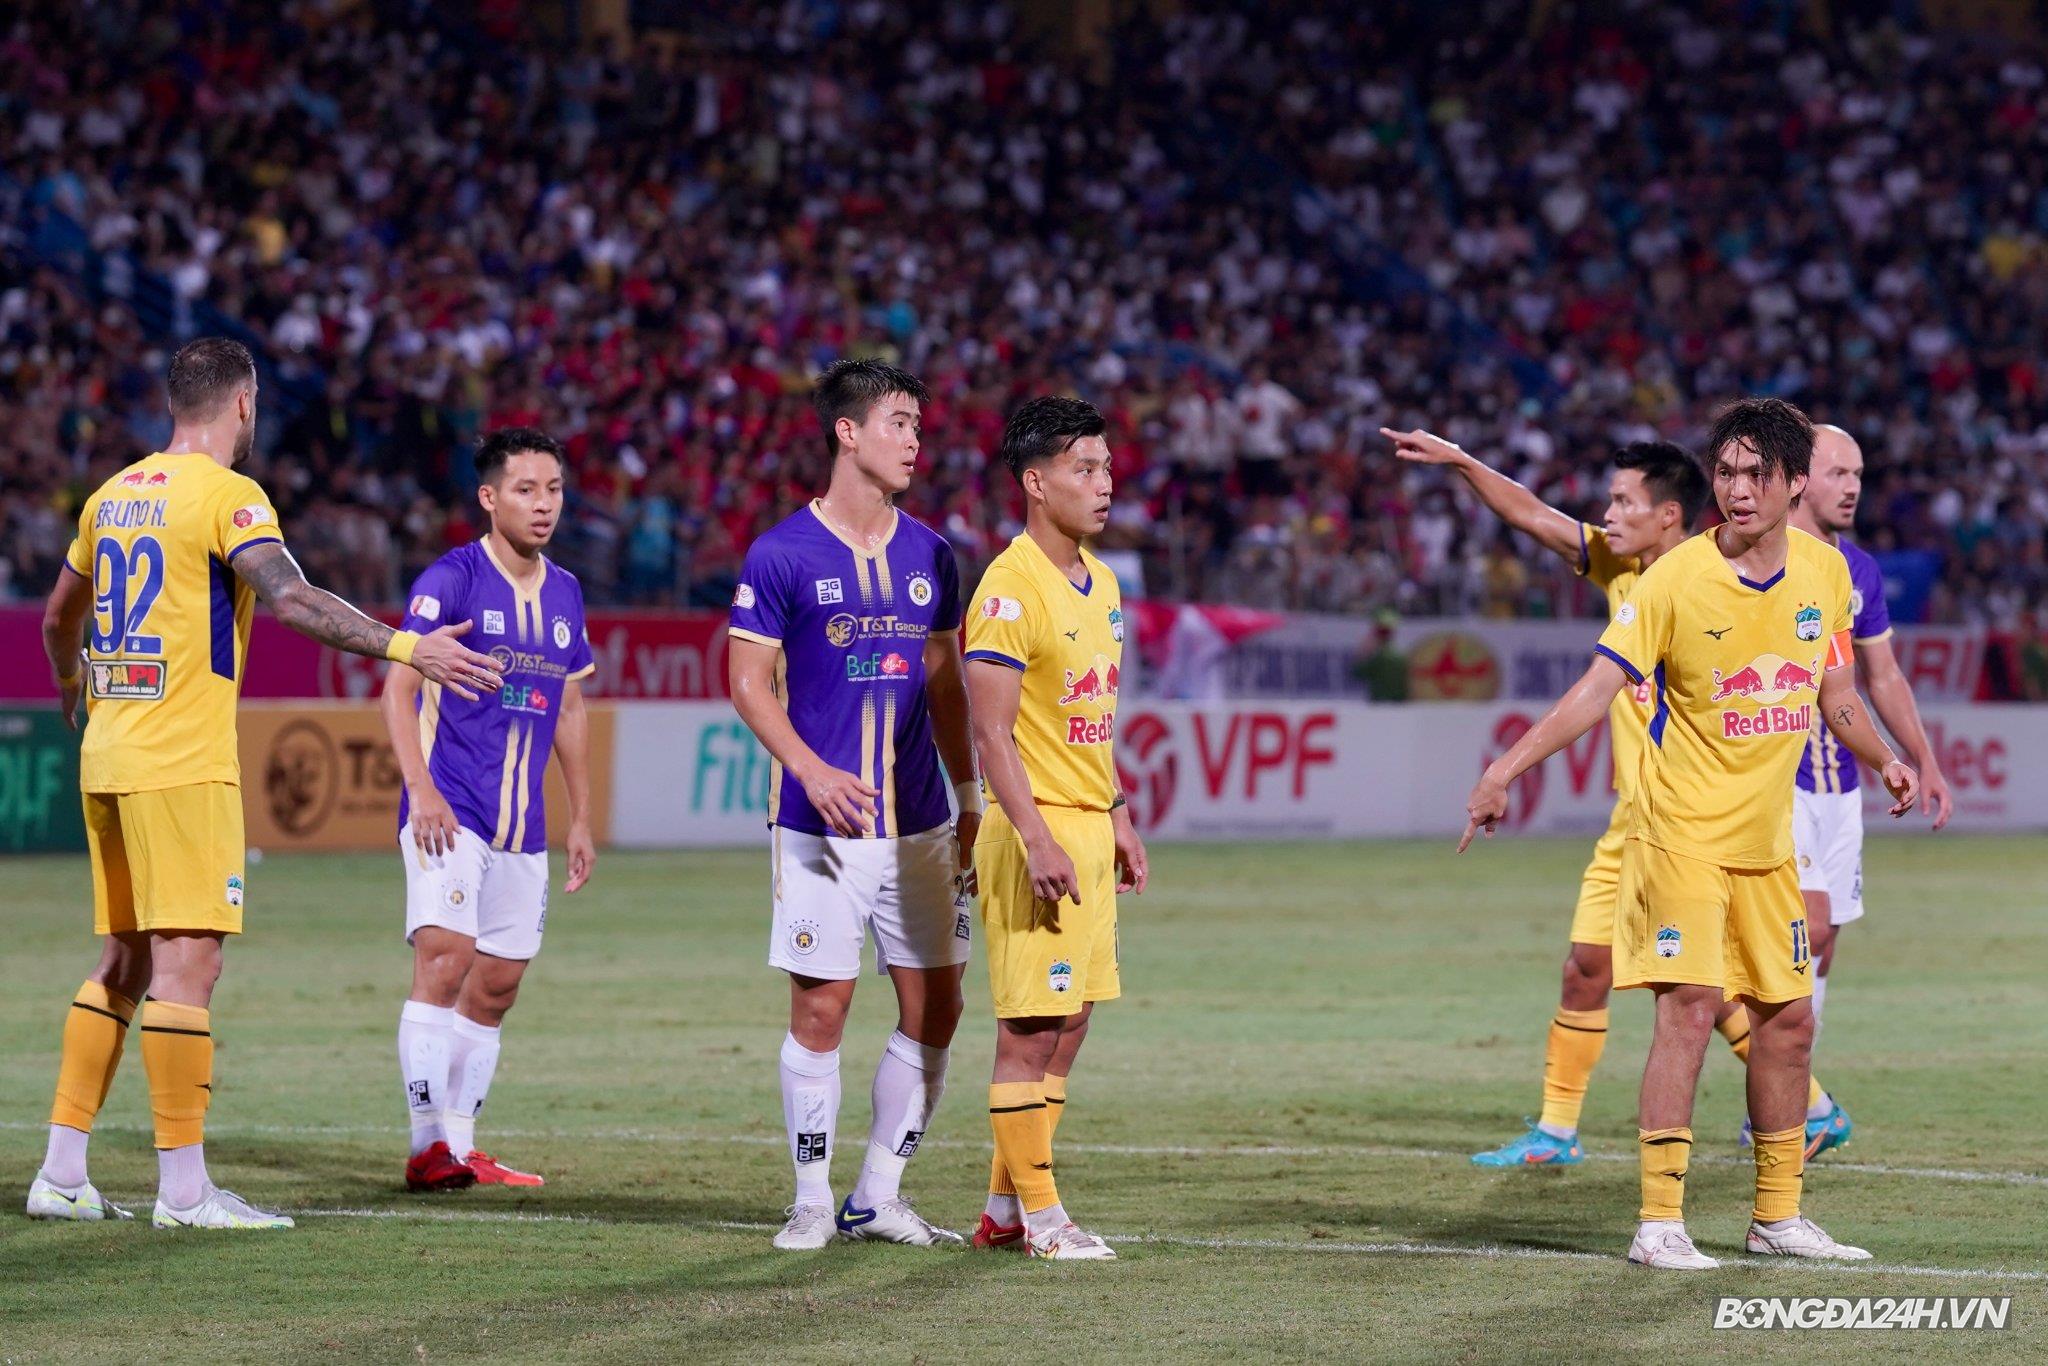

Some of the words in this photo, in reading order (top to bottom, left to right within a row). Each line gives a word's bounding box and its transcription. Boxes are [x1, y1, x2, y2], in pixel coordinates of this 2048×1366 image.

[96, 500, 150, 528] BRUNO
[91, 536, 165, 653] 92
[112, 665, 158, 686] BAPI
[847, 653, 882, 677] BaF
[1068, 713, 1107, 743] Red
[1723, 708, 1769, 737] Red
[1771, 704, 1810, 732] Bull
[1190, 712, 1335, 800] VPF
[1791, 919, 1808, 962] 11
